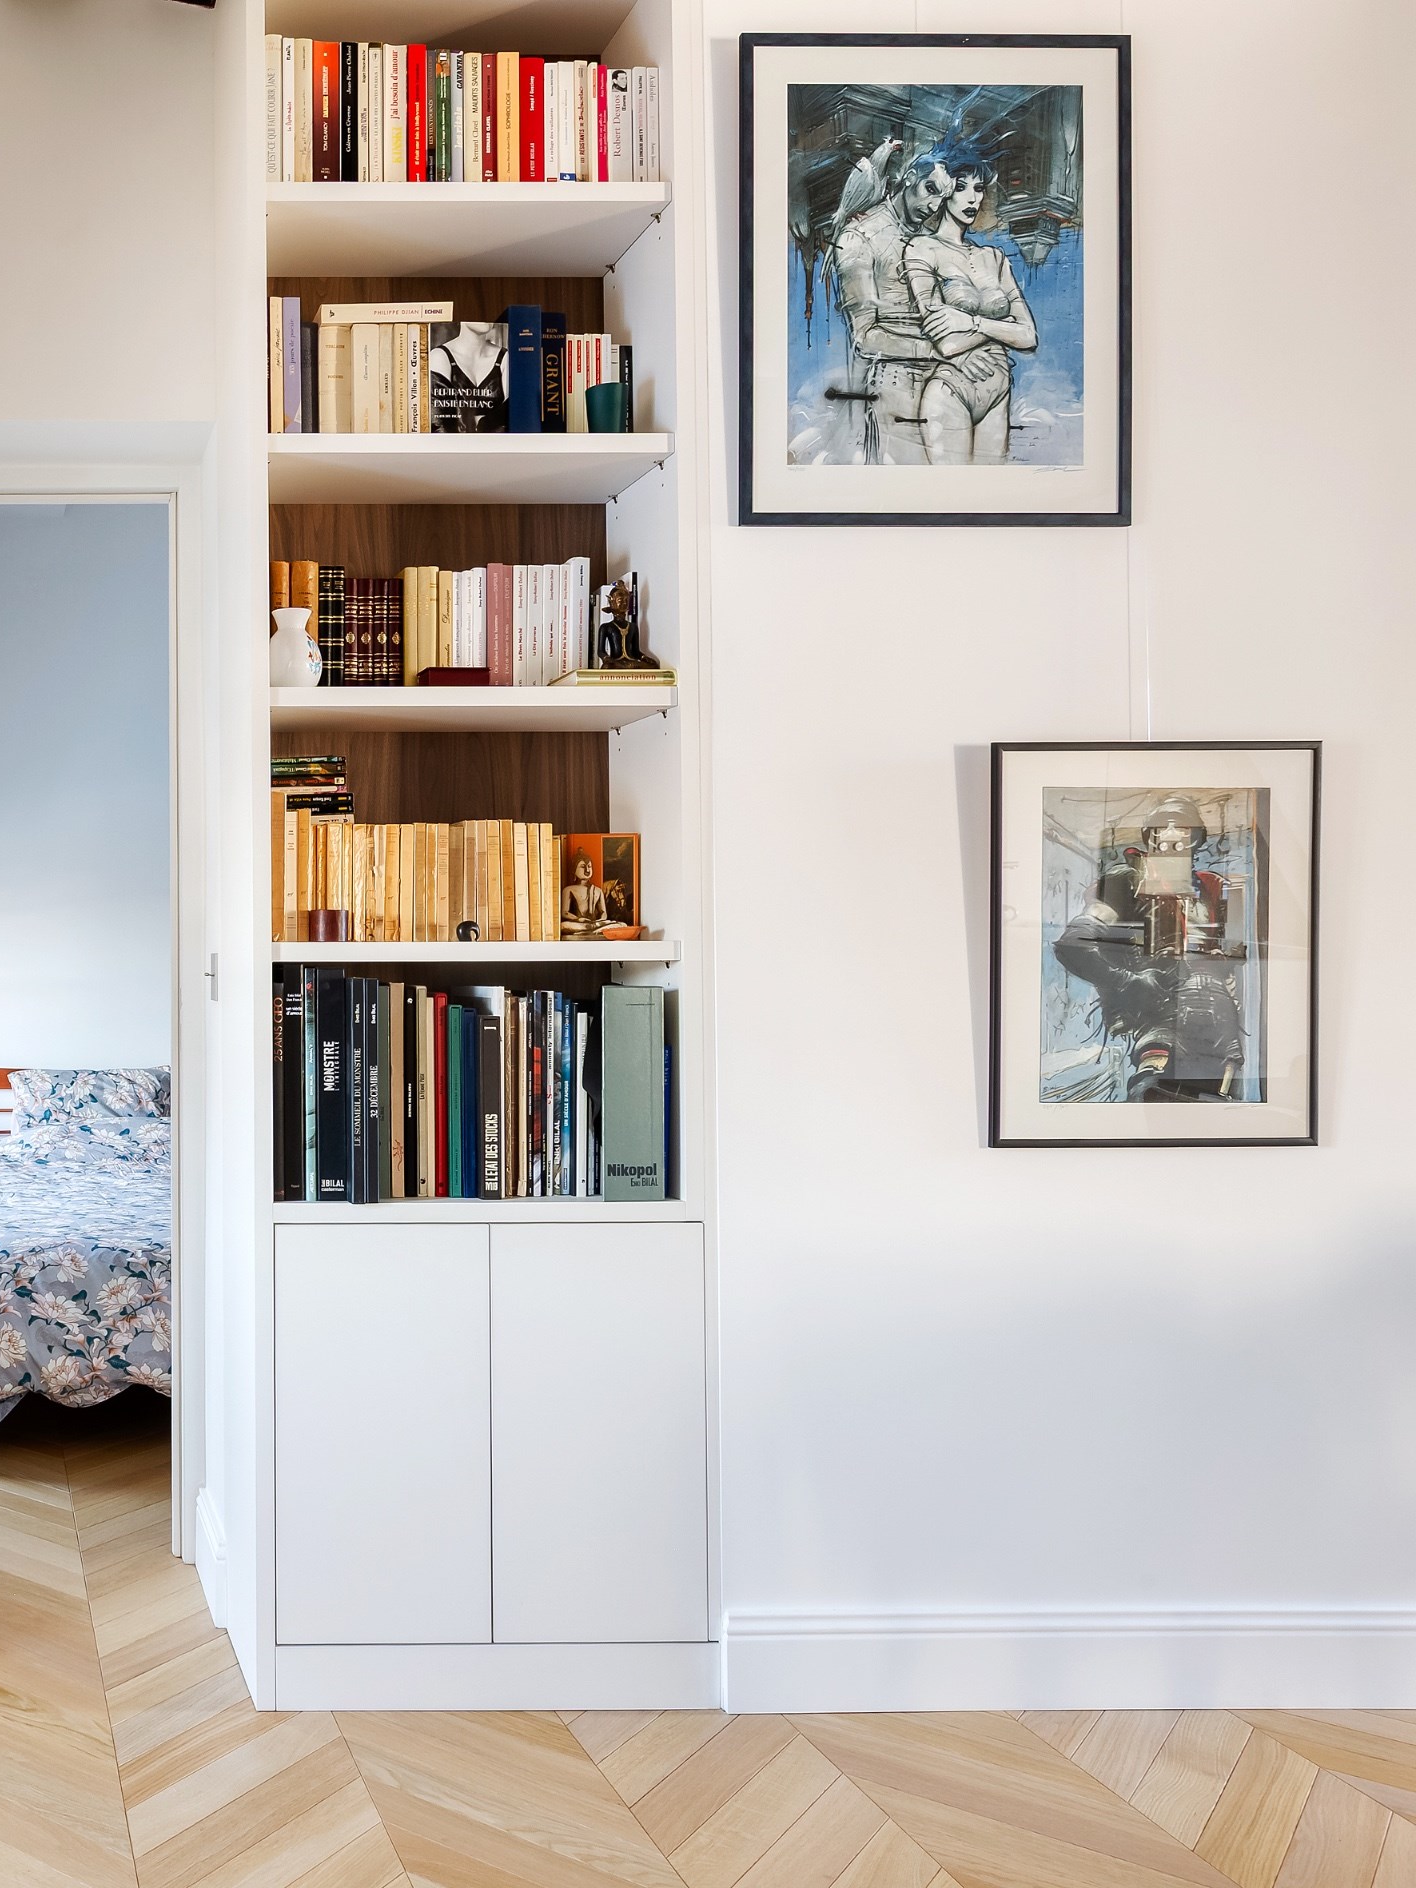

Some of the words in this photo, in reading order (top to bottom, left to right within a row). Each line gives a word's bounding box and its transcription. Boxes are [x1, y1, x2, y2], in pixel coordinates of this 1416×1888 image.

[390, 108, 400, 119] j'ai
[613, 94, 621, 124] Desnos
[267, 128, 276, 138] QUI
[613, 128, 621, 157] Robert
[267, 140, 276, 173] QU'EST-CE
[546, 354, 559, 415] GRANT
[412, 404, 420, 432] François
[273, 997, 283, 1023] GEO
[274, 1026, 282, 1048] ANS
[274, 1049, 282, 1062] 25
[323, 1041, 335, 1091] MONSTRE
[354, 1086, 361, 1096] DU
[369, 1066, 378, 1107] DÉCEMBRE
[370, 1110, 378, 1118] 32
[485, 1114, 498, 1142] STOCKS
[354, 1137, 361, 1146] LE
[485, 1144, 498, 1158] DES
[485, 1160, 498, 1181] L'ETAT
[608, 1163, 657, 1178] Nikopol
